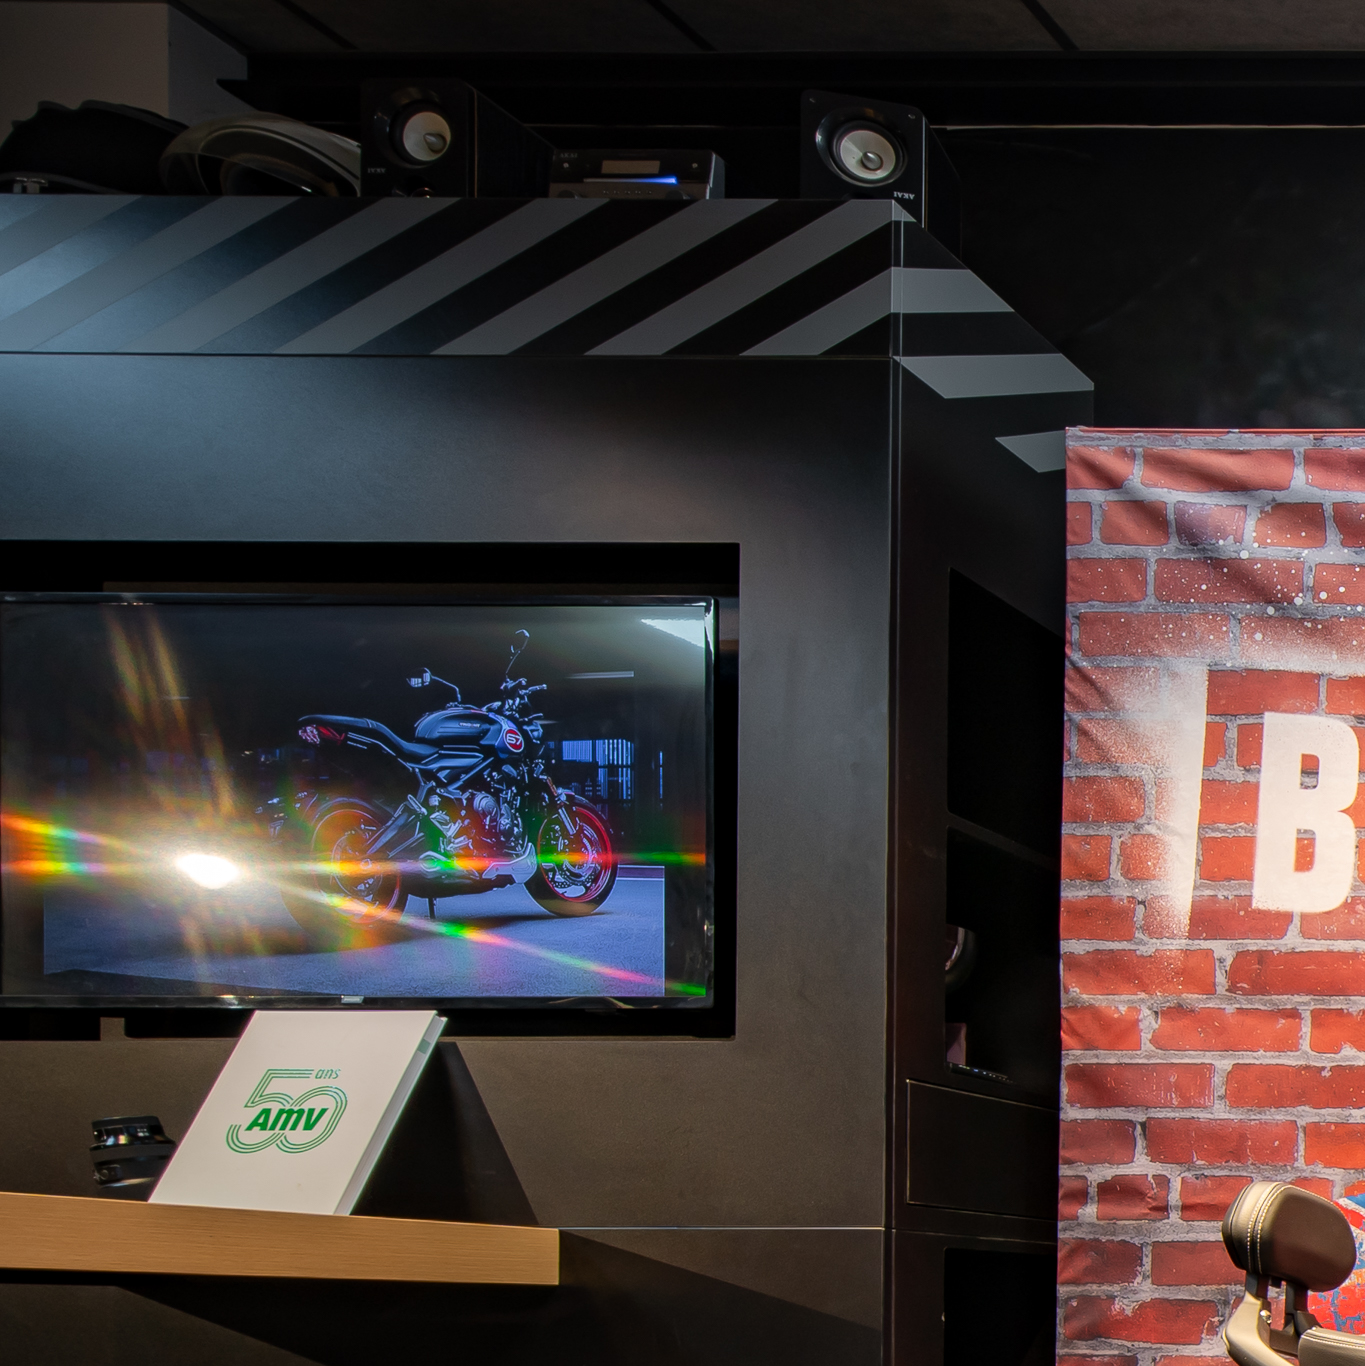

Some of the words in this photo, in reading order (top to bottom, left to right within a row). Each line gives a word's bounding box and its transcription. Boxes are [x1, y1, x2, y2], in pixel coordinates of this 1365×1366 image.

[506, 733, 521, 745] 67
[225, 1068, 348, 1154] 50
[314, 1067, 341, 1080] ans
